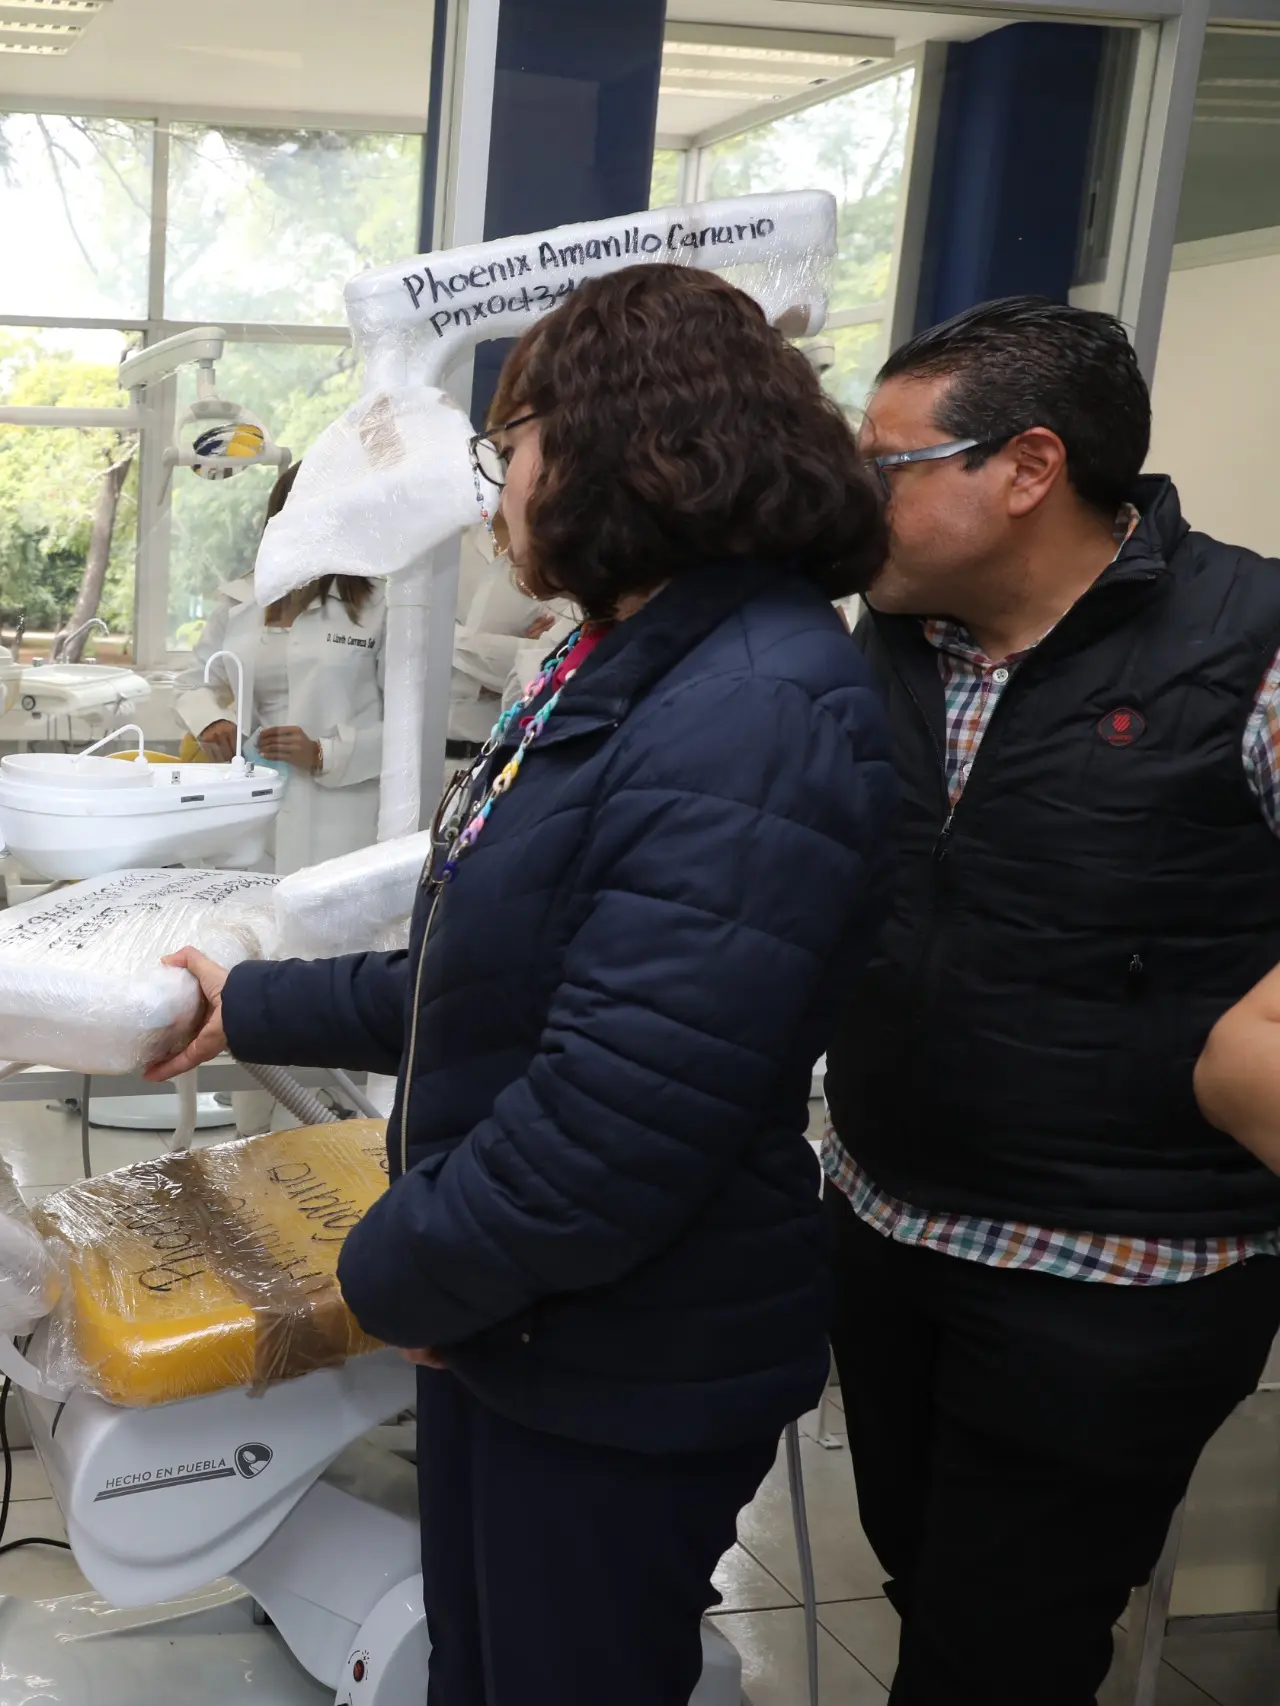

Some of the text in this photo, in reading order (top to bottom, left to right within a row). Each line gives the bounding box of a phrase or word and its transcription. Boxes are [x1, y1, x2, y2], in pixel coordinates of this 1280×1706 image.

[402, 254, 532, 310] Phoenix
[666, 217, 775, 251] Canario
[105, 1457, 227, 1489] HECHO EN PUEBLA
